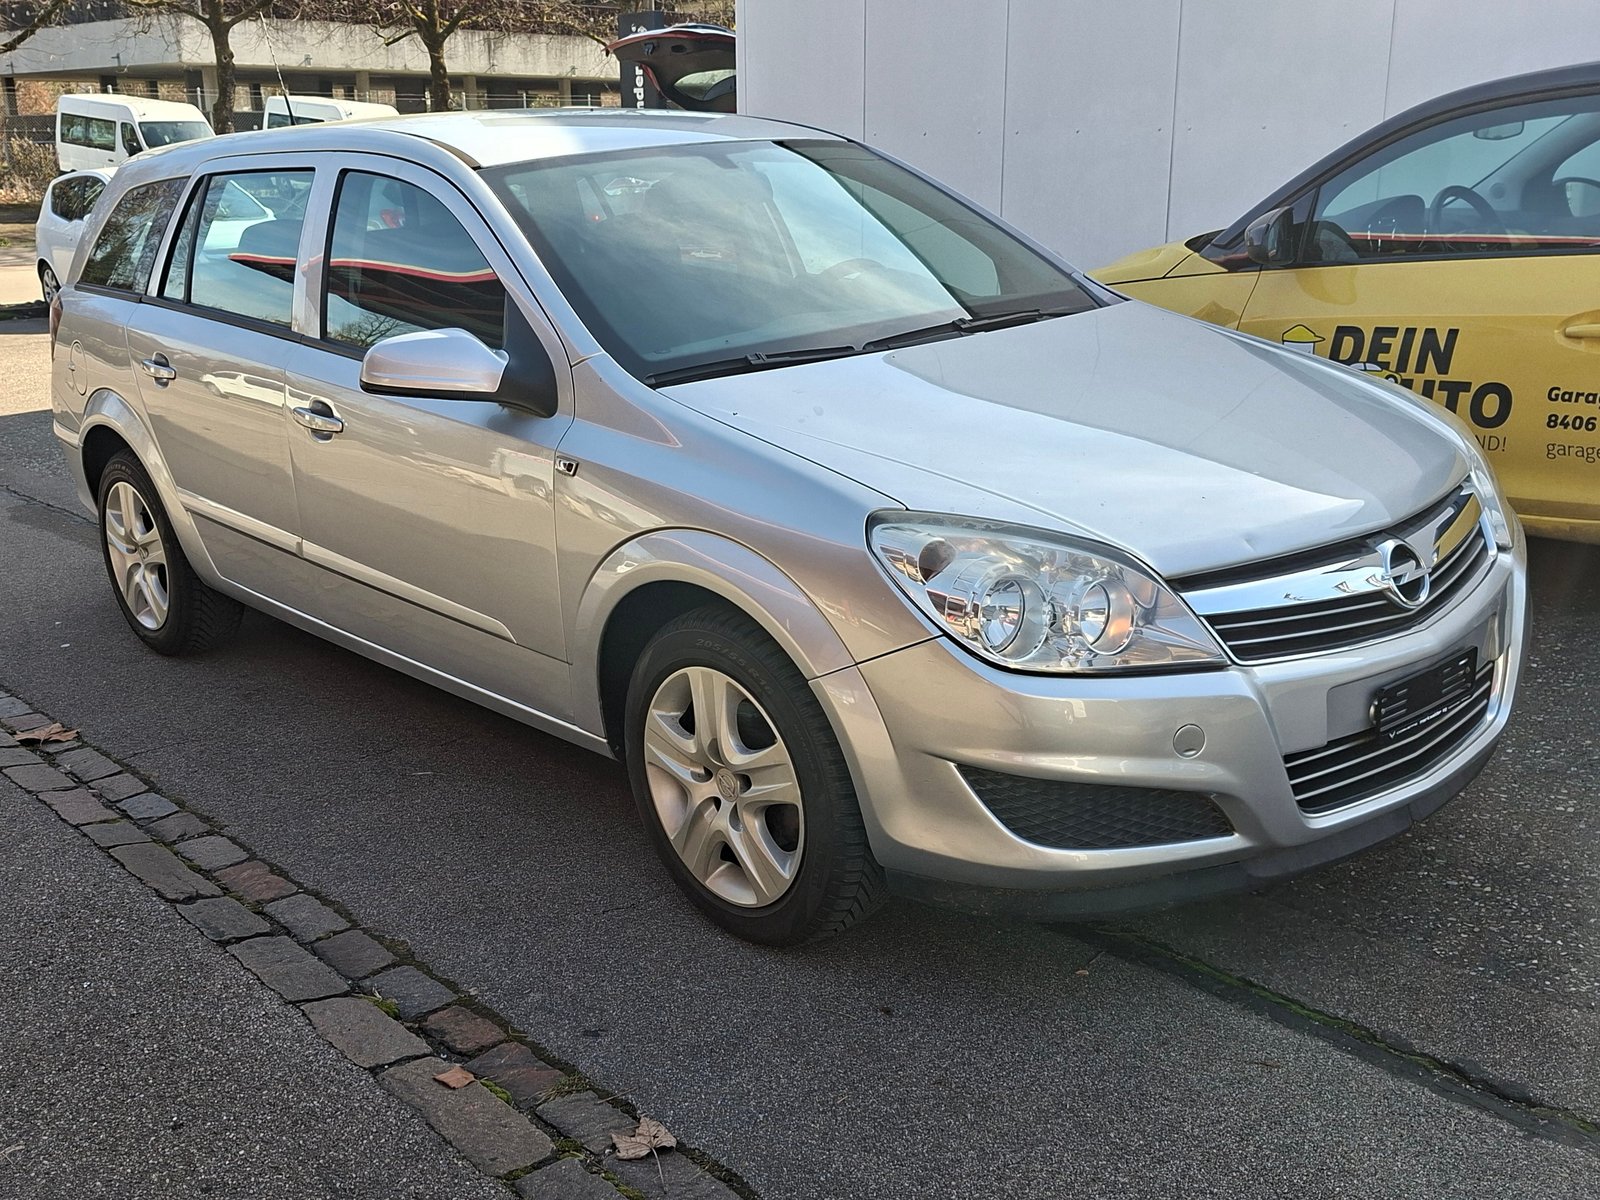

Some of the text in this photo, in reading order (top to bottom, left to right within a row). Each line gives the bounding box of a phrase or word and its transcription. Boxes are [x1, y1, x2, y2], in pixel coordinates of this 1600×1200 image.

[633, 66, 645, 109] nder
[1328, 325, 1460, 376] DEIN
[1547, 386, 1600, 410] Gara
[1546, 413, 1598, 432] 8406
[1475, 435, 1507, 452] ND!
